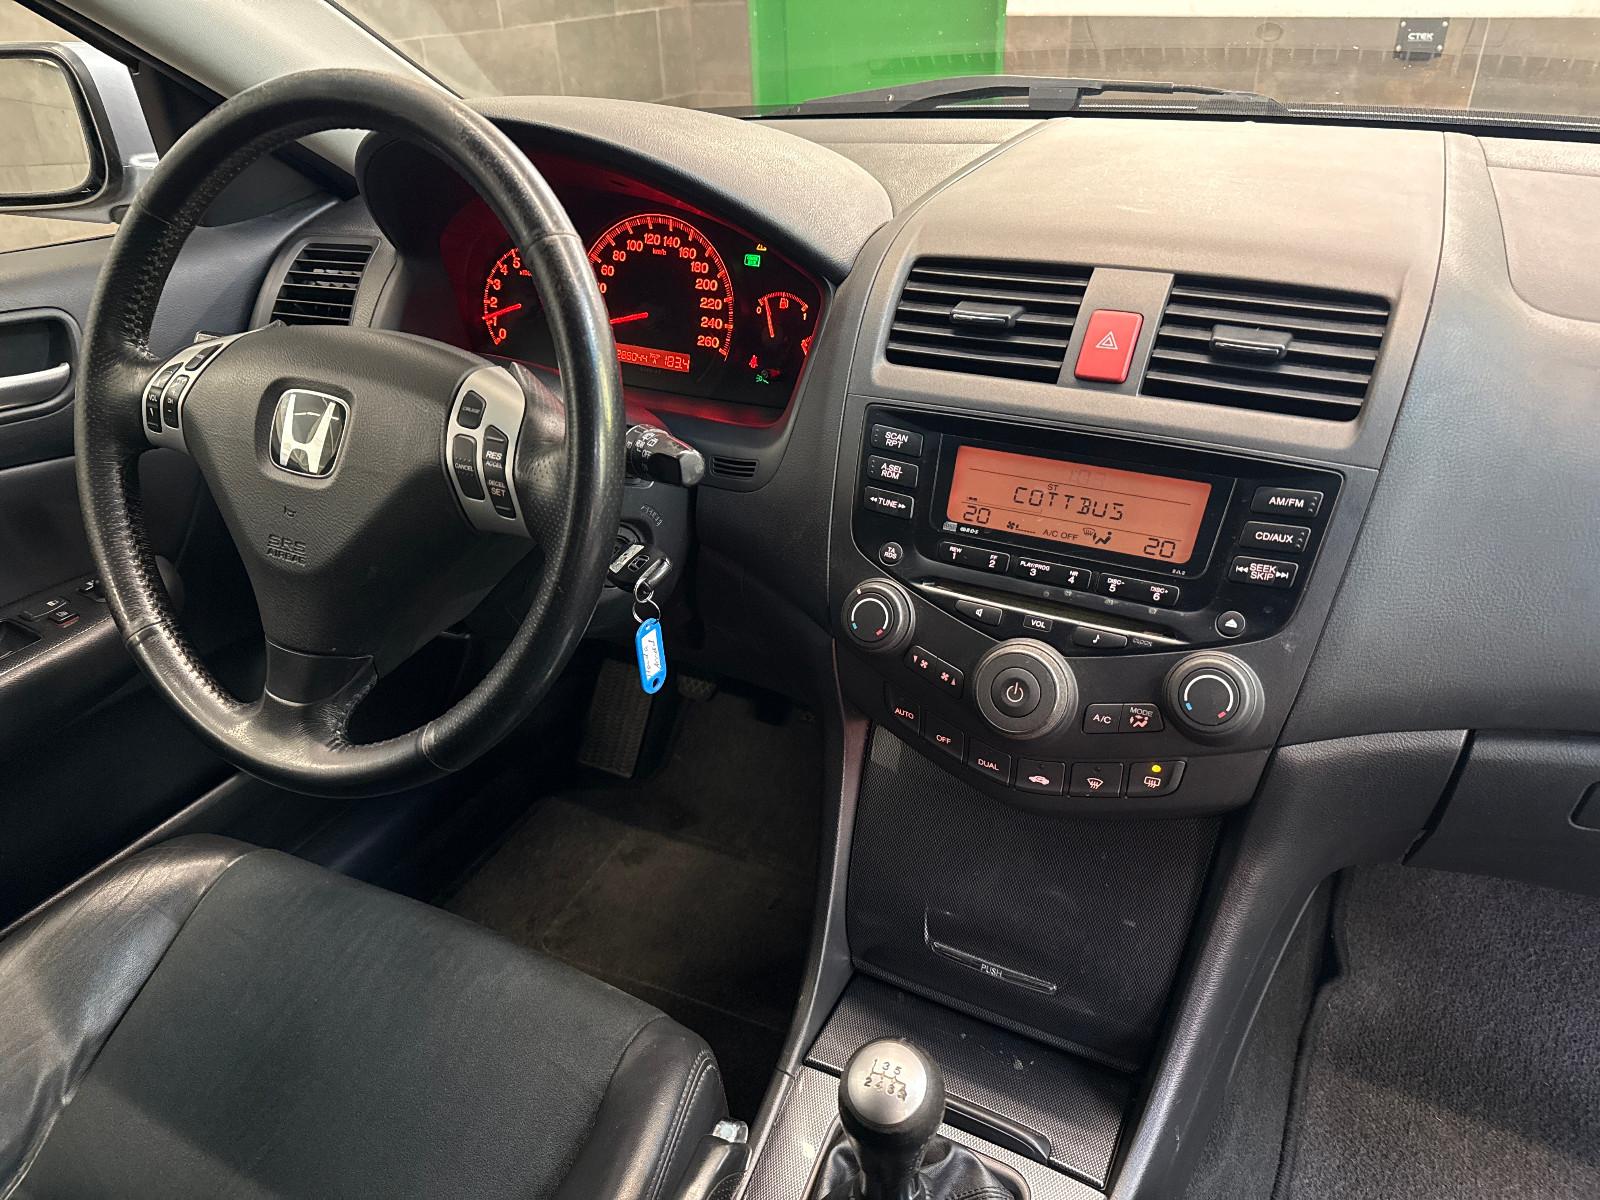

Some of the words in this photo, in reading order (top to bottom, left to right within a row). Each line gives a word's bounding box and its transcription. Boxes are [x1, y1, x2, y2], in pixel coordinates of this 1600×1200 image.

[1407, 32, 1434, 41] CTEK
[644, 233, 661, 245] 120
[663, 236, 681, 248] 140
[626, 240, 643, 252] 100
[612, 250, 626, 261] 80
[679, 247, 697, 259] 160
[512, 257, 520, 269] 5
[690, 261, 709, 274] 180
[500, 264, 508, 276] 4
[601, 264, 614, 276] 60
[493, 279, 501, 290] 3
[695, 278, 718, 291] 200
[490, 297, 498, 308] 2
[700, 297, 722, 310] 220
[756, 306, 762, 314] 0
[700, 316, 723, 329] 240
[499, 328, 507, 339] 0
[697, 335, 719, 348] 260
[884, 431, 909, 443] SCAN
[885, 439, 903, 448] RPT
[485, 450, 502, 461] RES
[454, 463, 474, 472] CANCEL
[880, 470, 900, 480] RDM
[490, 487, 506, 497] SET
[878, 497, 897, 508] TUNE
[1013, 486, 1125, 521] COTTBUS
[1268, 496, 1305, 508] AM/FM
[963, 505, 991, 524] 20
[1043, 529, 1058, 538] A/C
[1060, 531, 1079, 541] OFF
[1255, 531, 1294, 543] CD/AUX
[268, 534, 306, 552] SRS
[1144, 537, 1176, 559] 20
[884, 552, 897, 560] RDS
[988, 560, 996, 568] 2
[1250, 562, 1277, 574] SEEK
[1029, 568, 1037, 576] 3
[1250, 571, 1275, 581] SKIP
[1068, 576, 1075, 584] 4
[1108, 584, 1116, 592] 5
[1153, 593, 1160, 601] 6
[1031, 619, 1046, 628] VOL
[894, 707, 914, 720] AUTO
[1129, 706, 1154, 718] MODE
[1093, 714, 1112, 724] A/C
[936, 734, 951, 745] OFF
[977, 758, 1000, 771] DUAL
[980, 963, 1003, 977] PUSH
[882, 1061, 890, 1071] 3
[893, 1066, 902, 1075] 5
[863, 1077, 872, 1087] 2
